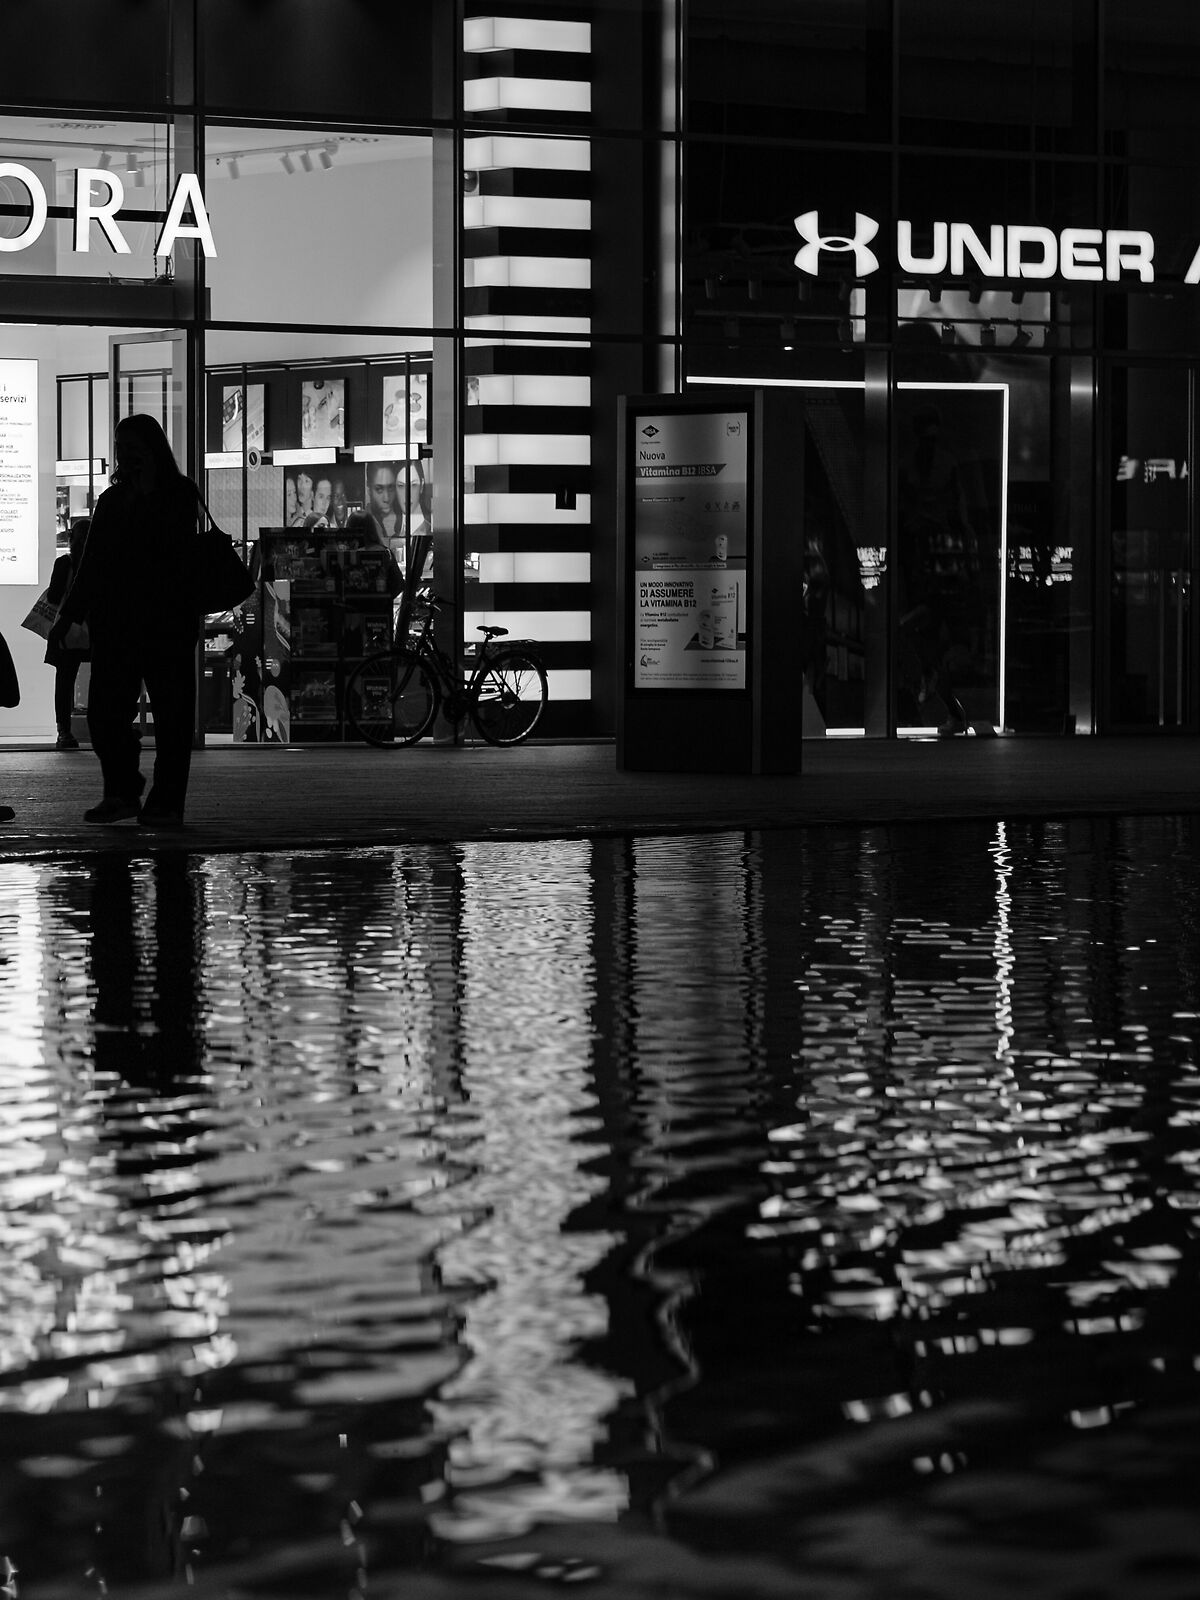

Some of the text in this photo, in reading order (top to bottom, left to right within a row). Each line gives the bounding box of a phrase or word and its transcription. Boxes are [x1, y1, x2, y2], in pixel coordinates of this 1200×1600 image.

[897, 220, 1155, 283] UNDER
[0, 394, 27, 403] servizi
[639, 451, 666, 460] Nuova
[640, 465, 717, 477] Vitamina B12 IBSA
[640, 589, 694, 598] DI ASSUMERE
[684, 600, 697, 608] B12
